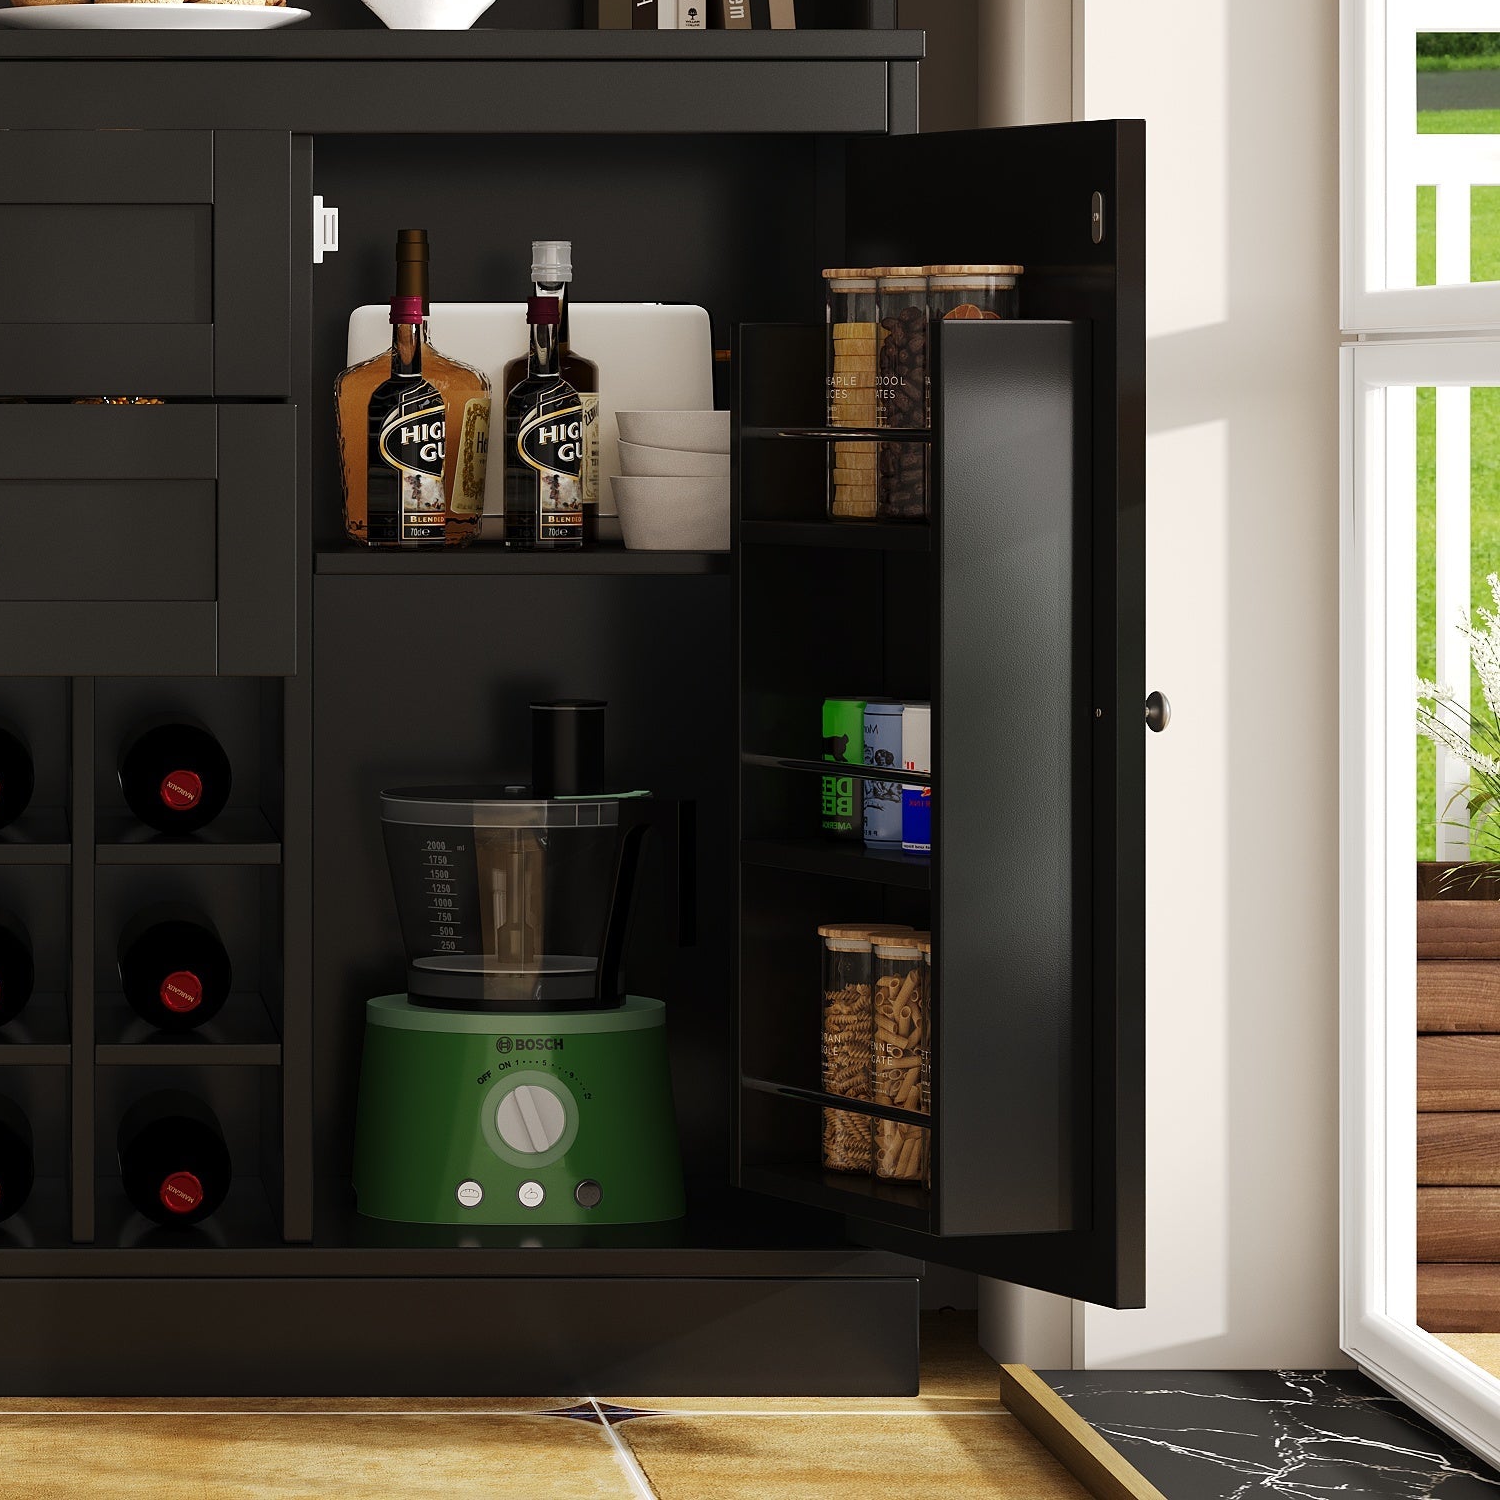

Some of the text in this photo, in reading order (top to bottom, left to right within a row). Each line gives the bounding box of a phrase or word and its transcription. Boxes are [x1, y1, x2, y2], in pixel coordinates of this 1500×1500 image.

[166, 780, 195, 800] MARGAUX
[426, 840, 446, 850] 2000
[428, 855, 448, 865] 1750
[430, 869, 449, 879] 1500
[431, 884, 451, 893] 1250
[433, 898, 453, 907] 1000
[437, 912, 452, 922] 750
[439, 926, 454, 936] 500
[441, 941, 456, 950] 250
[166, 982, 195, 1003] MARGAUX
[515, 1038, 564, 1051] BOSCH
[498, 1060, 512, 1071] ON
[476, 1069, 493, 1085] OFF
[583, 1092, 592, 1100] 12
[166, 1183, 195, 1204] MARGAUX
